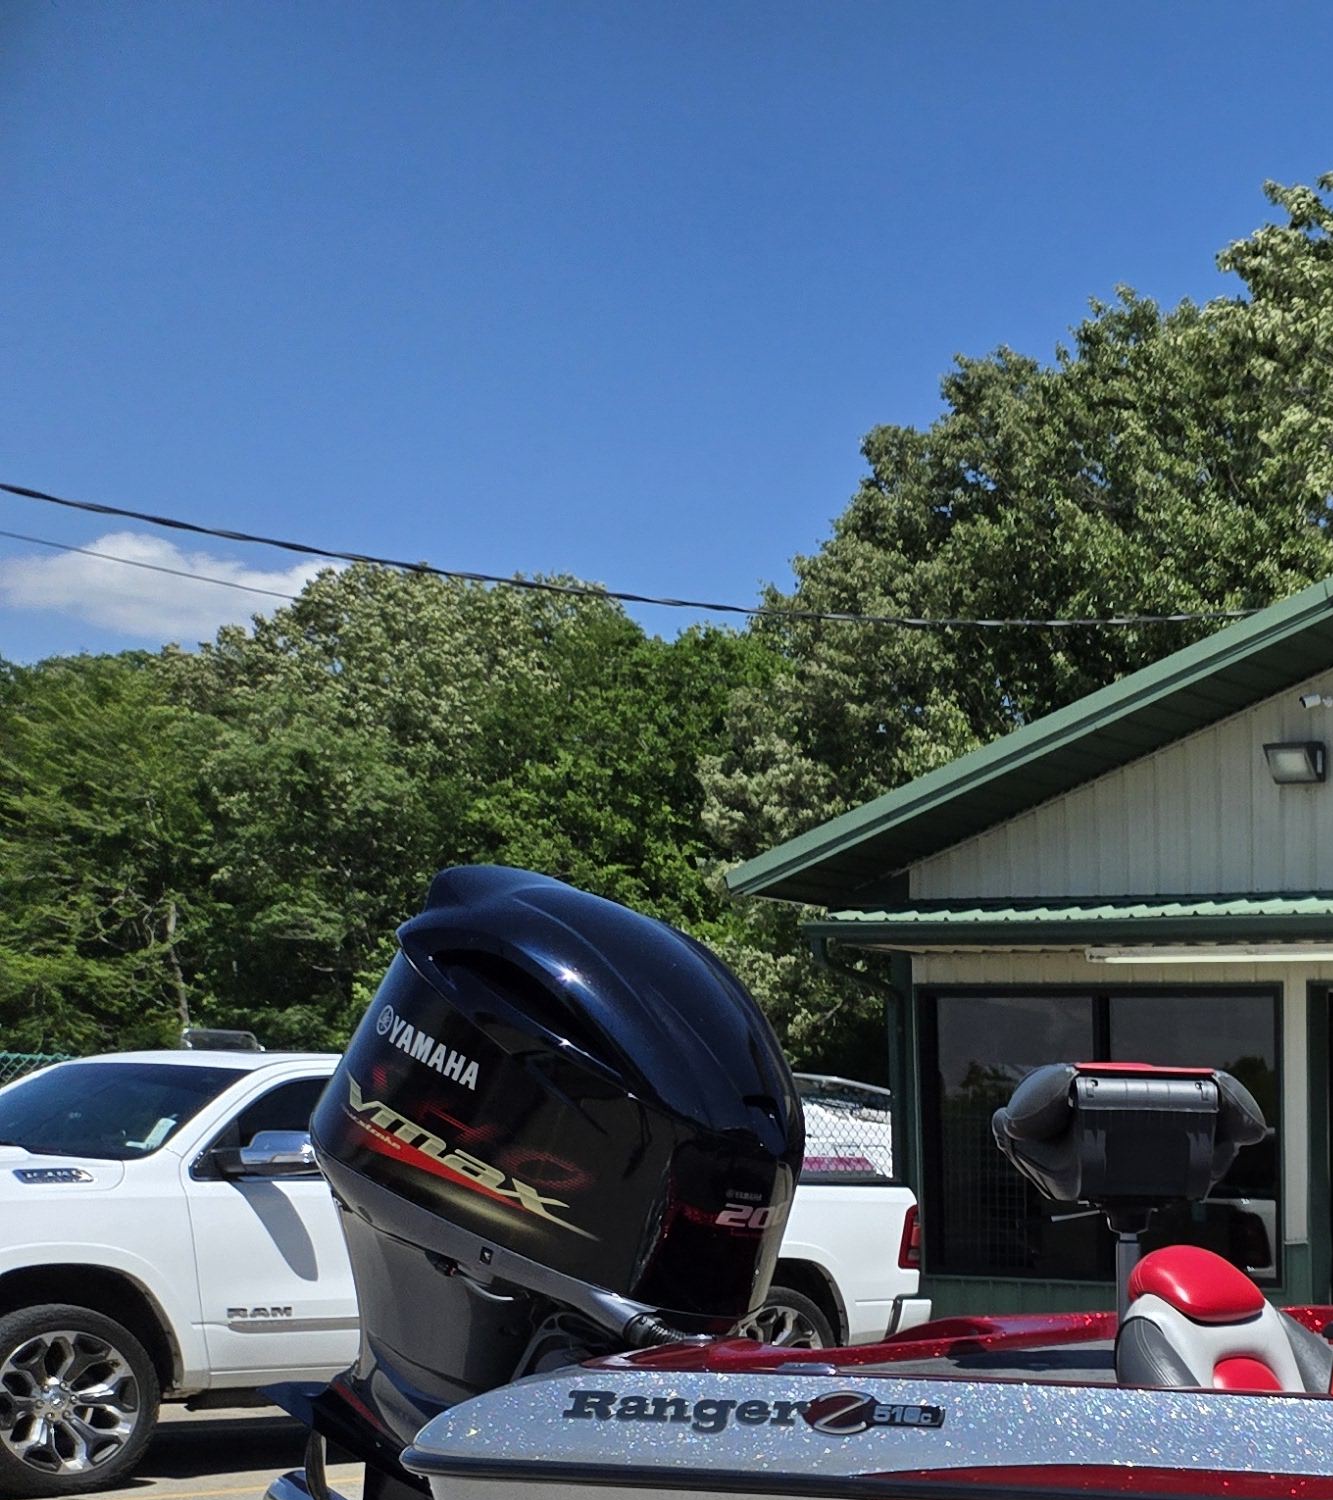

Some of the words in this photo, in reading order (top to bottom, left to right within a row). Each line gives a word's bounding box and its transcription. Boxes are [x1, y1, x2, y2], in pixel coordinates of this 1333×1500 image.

[388, 1015, 480, 1091] YAMAHA
[227, 1306, 293, 1319] RAM
[562, 1390, 811, 1434] Ranger
